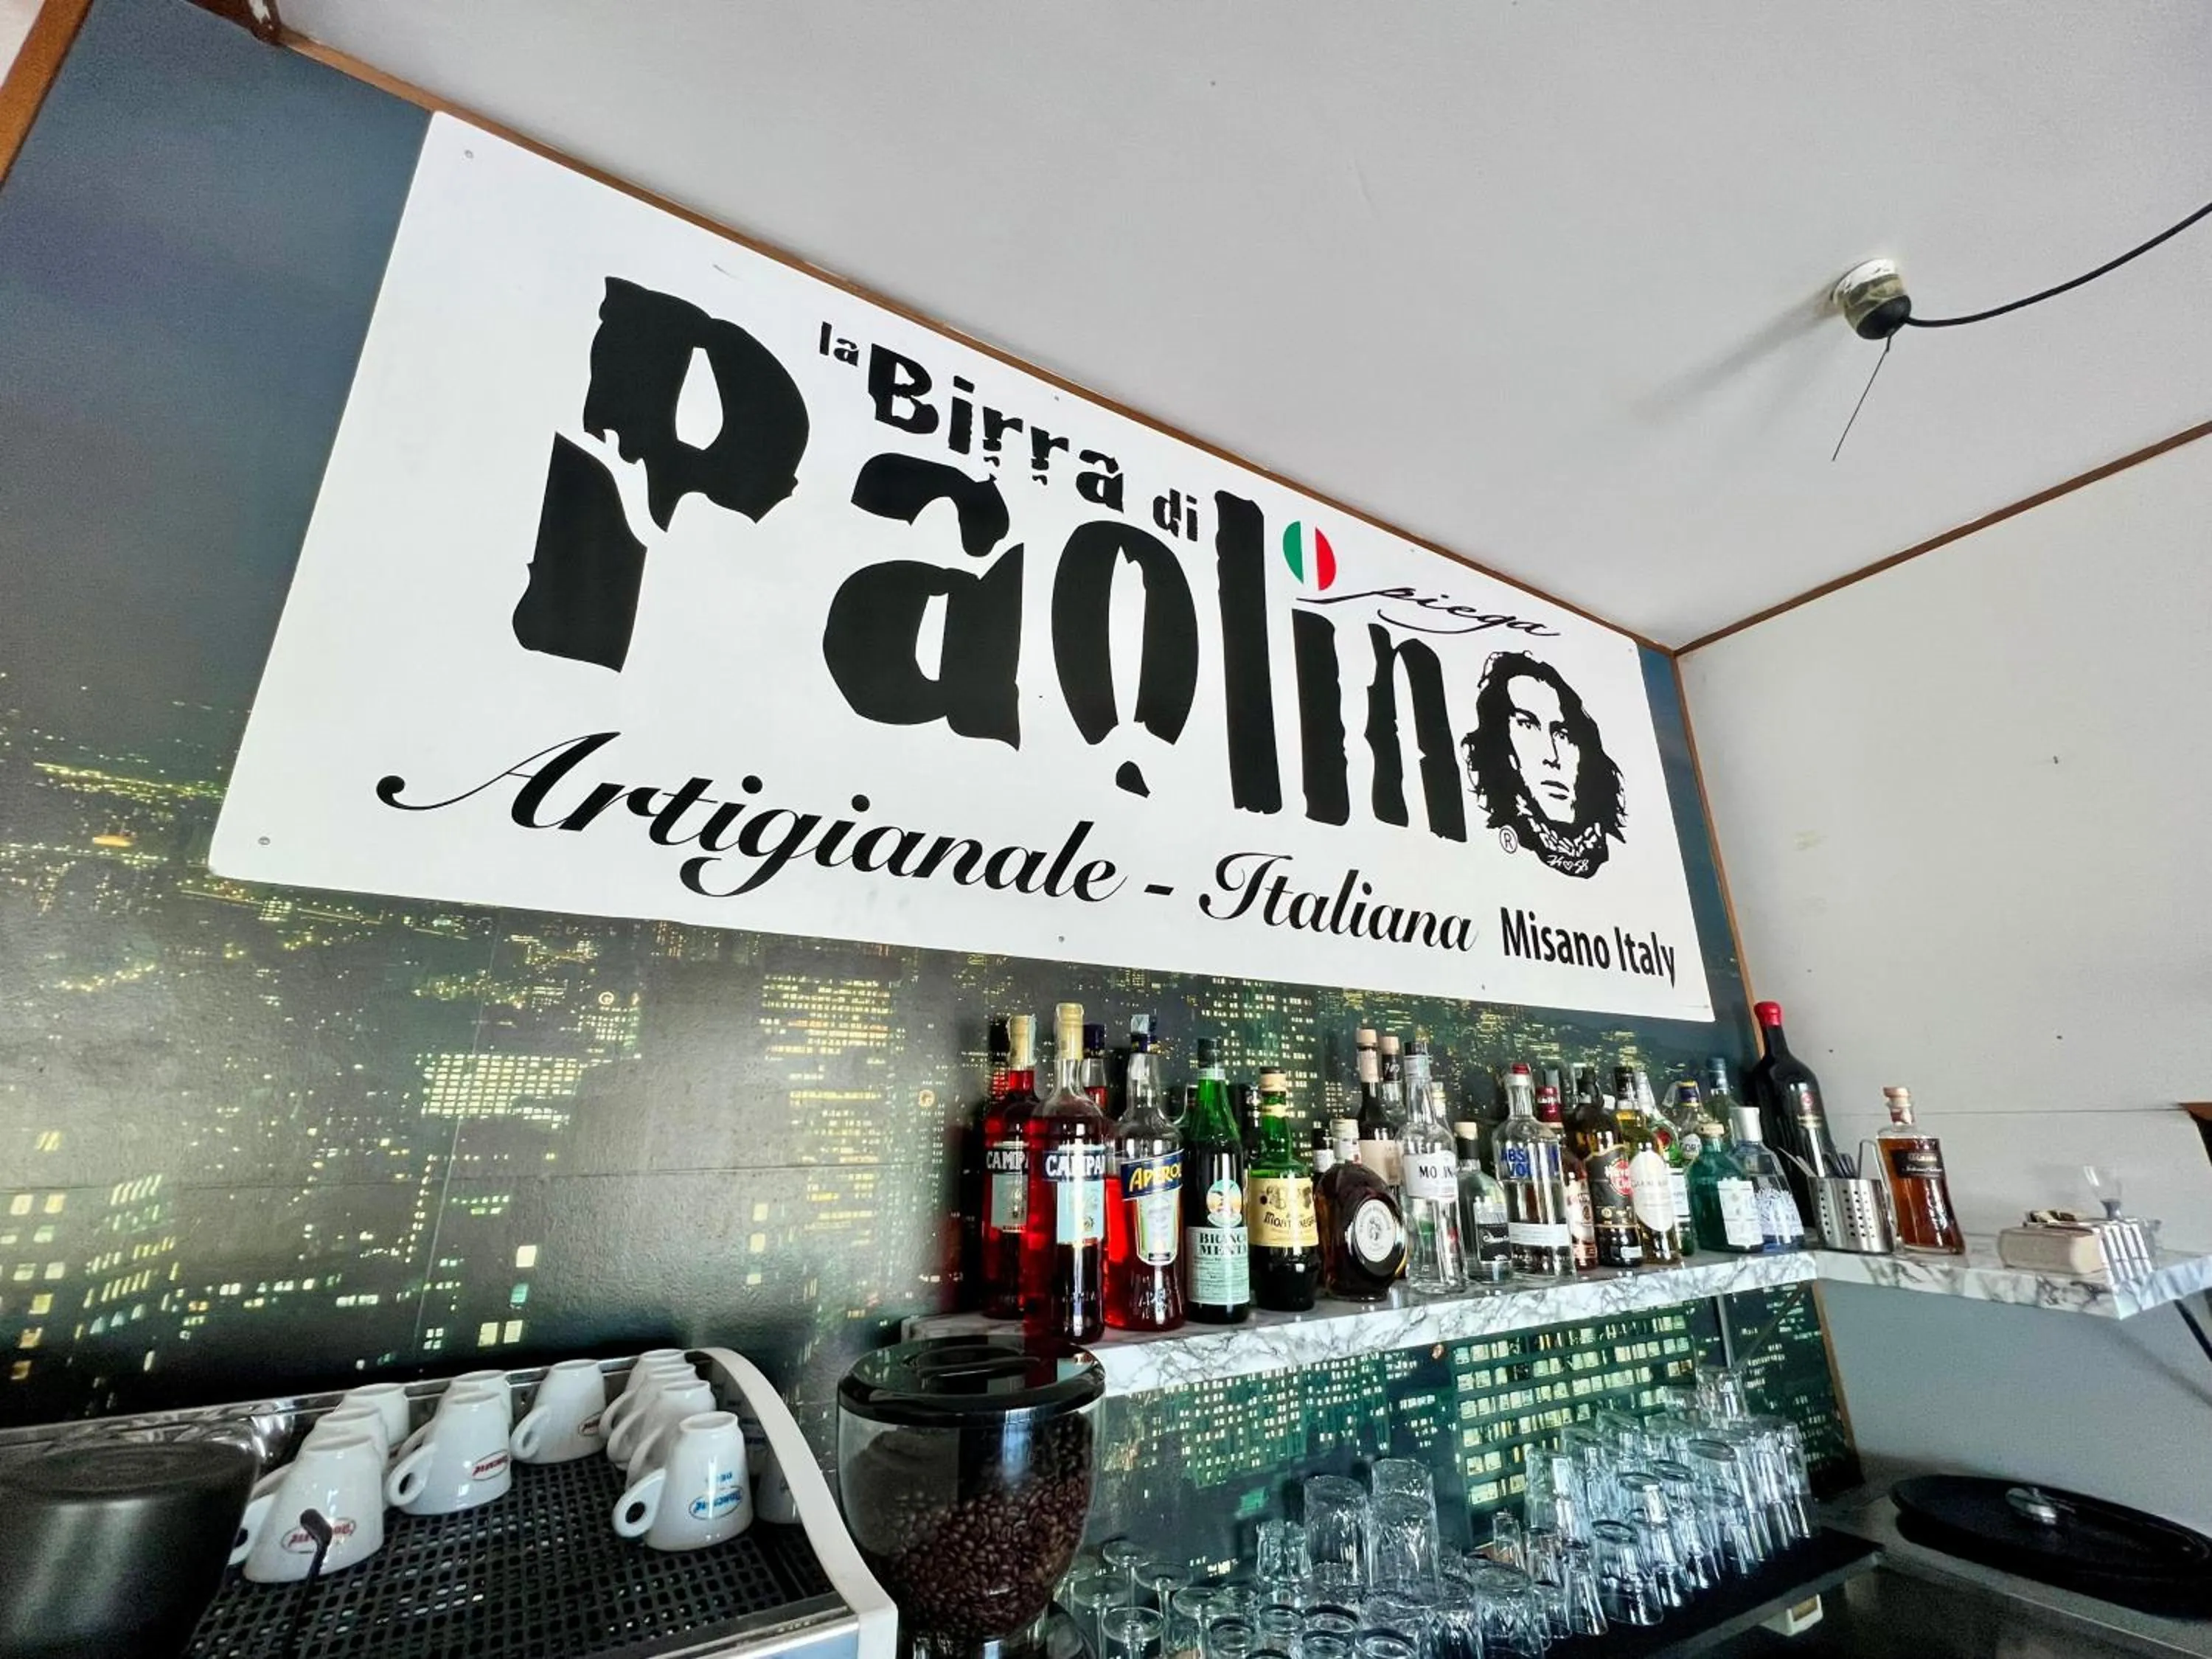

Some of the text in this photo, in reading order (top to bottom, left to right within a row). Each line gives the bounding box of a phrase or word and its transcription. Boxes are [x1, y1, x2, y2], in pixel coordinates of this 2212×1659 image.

[819, 321, 1198, 542] la Birra di
[1296, 587, 1561, 636] piega
[375, 731, 1128, 902] Artigianale
[1198, 852, 1477, 952] Italiana
[1500, 906, 1675, 988] Misano Italy
